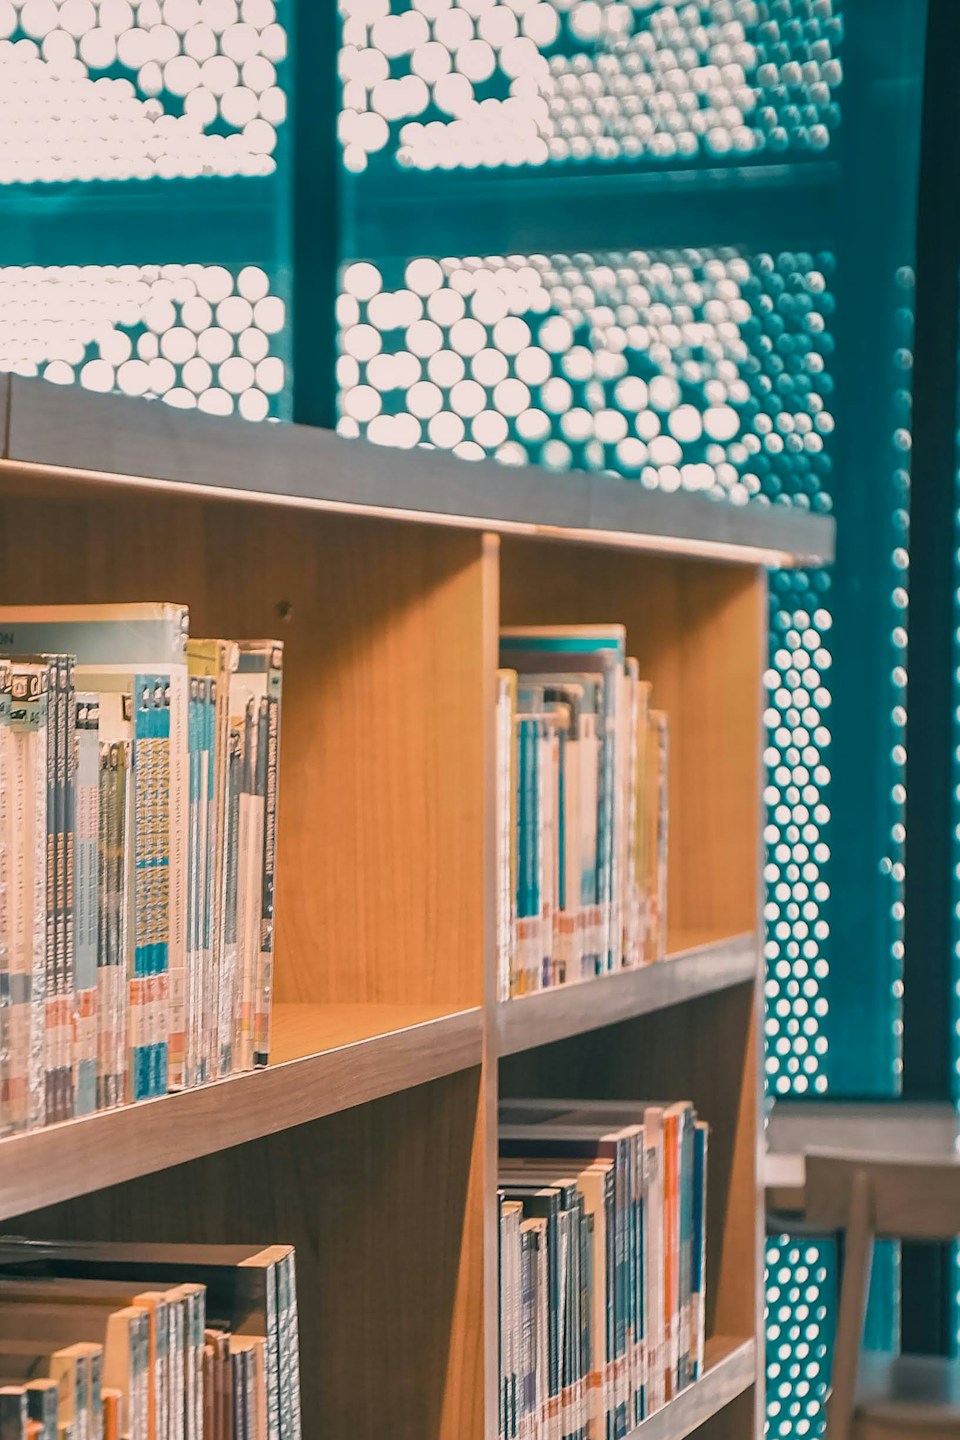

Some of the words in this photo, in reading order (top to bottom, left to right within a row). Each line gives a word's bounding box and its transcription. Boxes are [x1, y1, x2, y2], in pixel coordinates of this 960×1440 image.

[268, 702, 278, 736] SUPPLY
[268, 737, 277, 765] CHAIN
[267, 767, 276, 812] LOGISTICS
[265, 814, 275, 875] MANAGEMENT
[47, 832, 55, 909] PENGANTAR
[47, 914, 55, 967] TEKNIK
